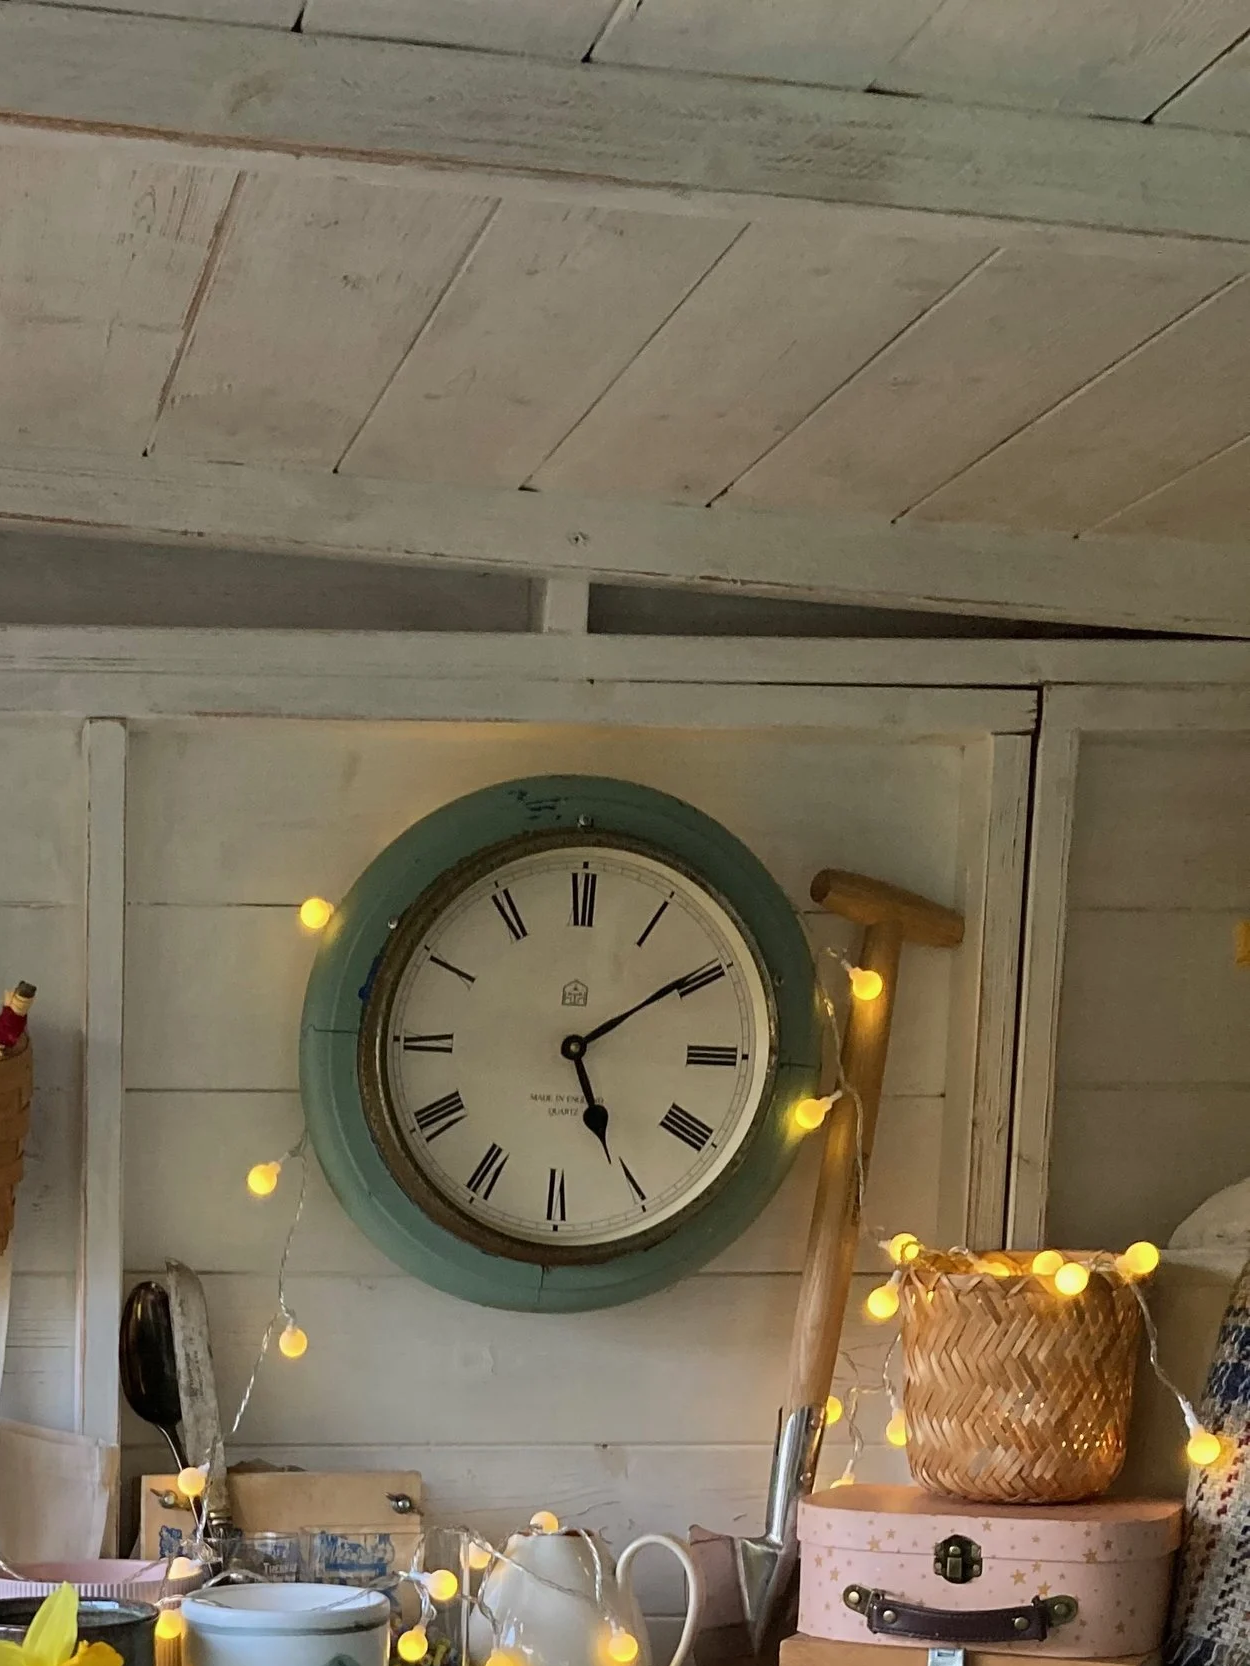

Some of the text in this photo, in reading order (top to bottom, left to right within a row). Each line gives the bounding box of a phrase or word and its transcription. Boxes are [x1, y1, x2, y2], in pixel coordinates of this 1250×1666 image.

[529, 1092, 552, 1102] MADE
[555, 1093, 564, 1103] IN
[548, 1107, 579, 1117] QUARTZ
